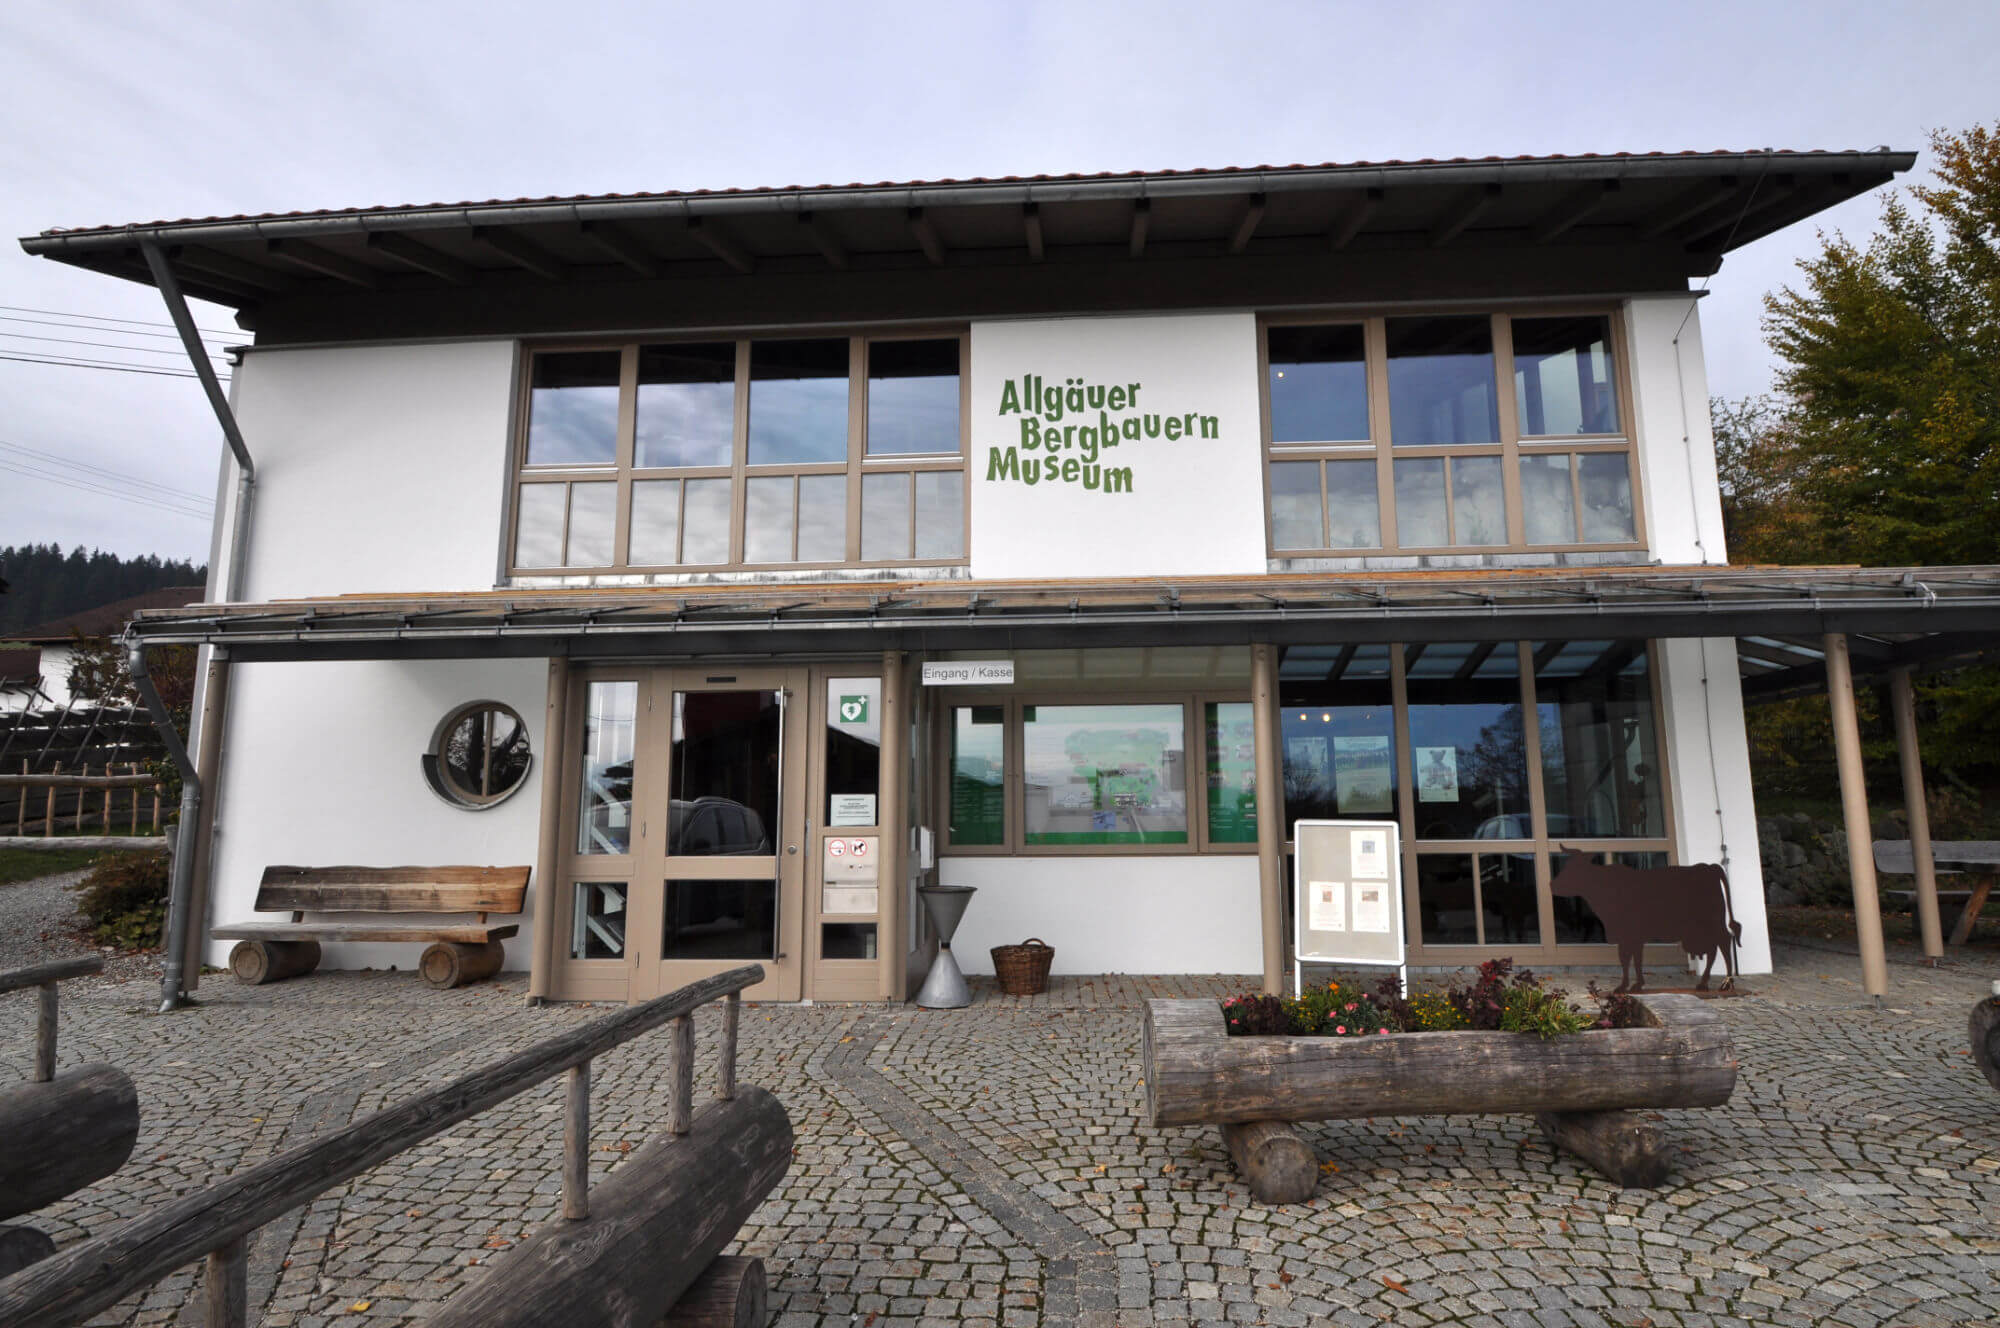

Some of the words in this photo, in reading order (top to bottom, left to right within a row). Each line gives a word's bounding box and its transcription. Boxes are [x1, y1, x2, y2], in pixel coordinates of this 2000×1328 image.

[998, 373, 1141, 421] Allgäuer
[1020, 411, 1219, 463] Bergbauern
[985, 446, 1133, 493] Museum
[923, 668, 968, 680] Eingang
[979, 667, 1013, 678] Kasse
